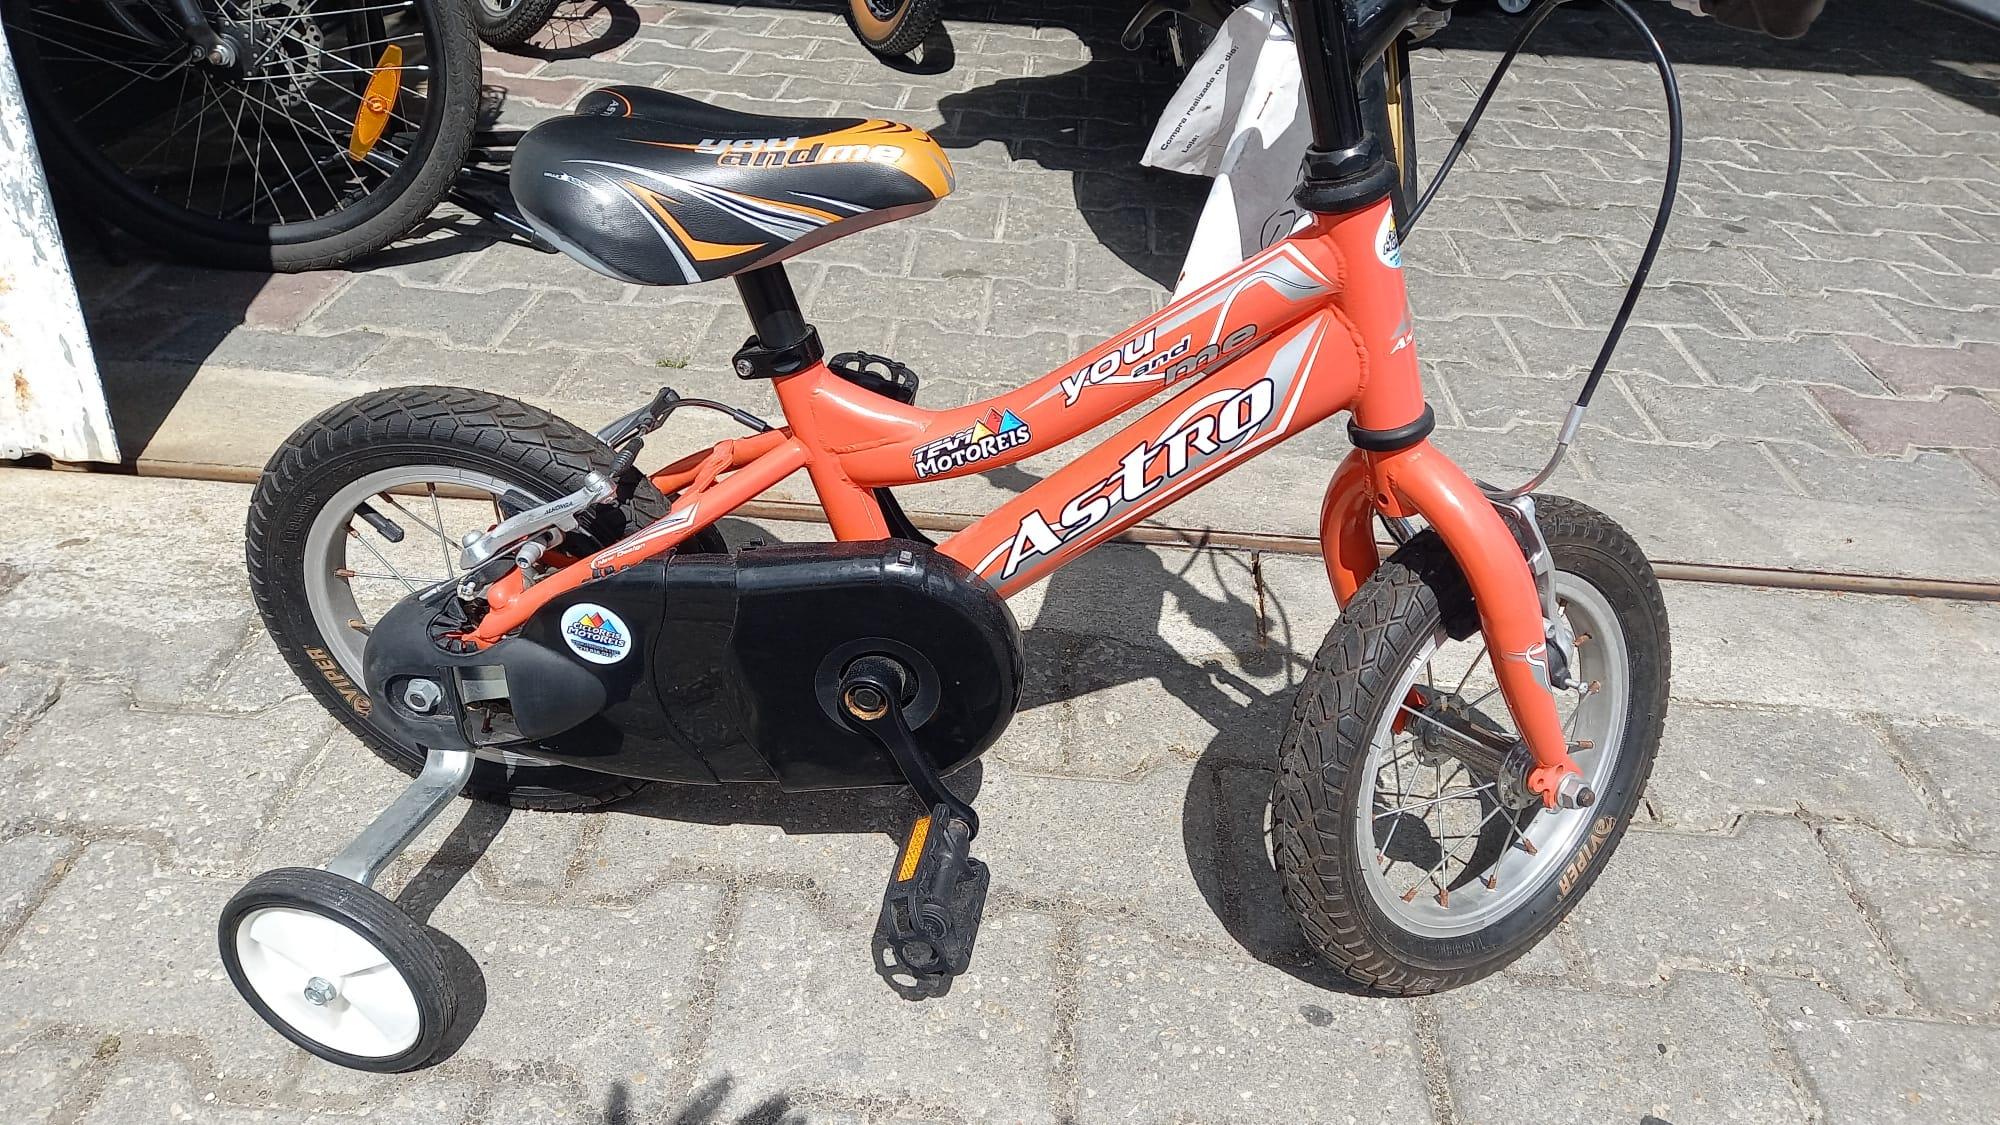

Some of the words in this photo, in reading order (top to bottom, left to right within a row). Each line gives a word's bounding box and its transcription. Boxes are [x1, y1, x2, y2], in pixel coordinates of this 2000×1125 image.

[1160, 117, 1187, 151] Compra
[1186, 76, 1215, 116] realizada
[1215, 63, 1225, 76] no
[1225, 44, 1240, 62] dia:
[717, 142, 824, 169] and
[820, 143, 905, 165] me
[1181, 134, 1200, 153] Loja:
[1060, 327, 1157, 408] you
[1130, 334, 1192, 379] and
[1164, 324, 1258, 386] me
[915, 425, 1031, 478] MOTOREIS
[616, 542, 646, 557] Design
[567, 626, 626, 647] MOTOREIS
[573, 621, 622, 639] CICLOREIS
[305, 647, 358, 706] VIPER
[1558, 833, 1607, 896] VIPER
